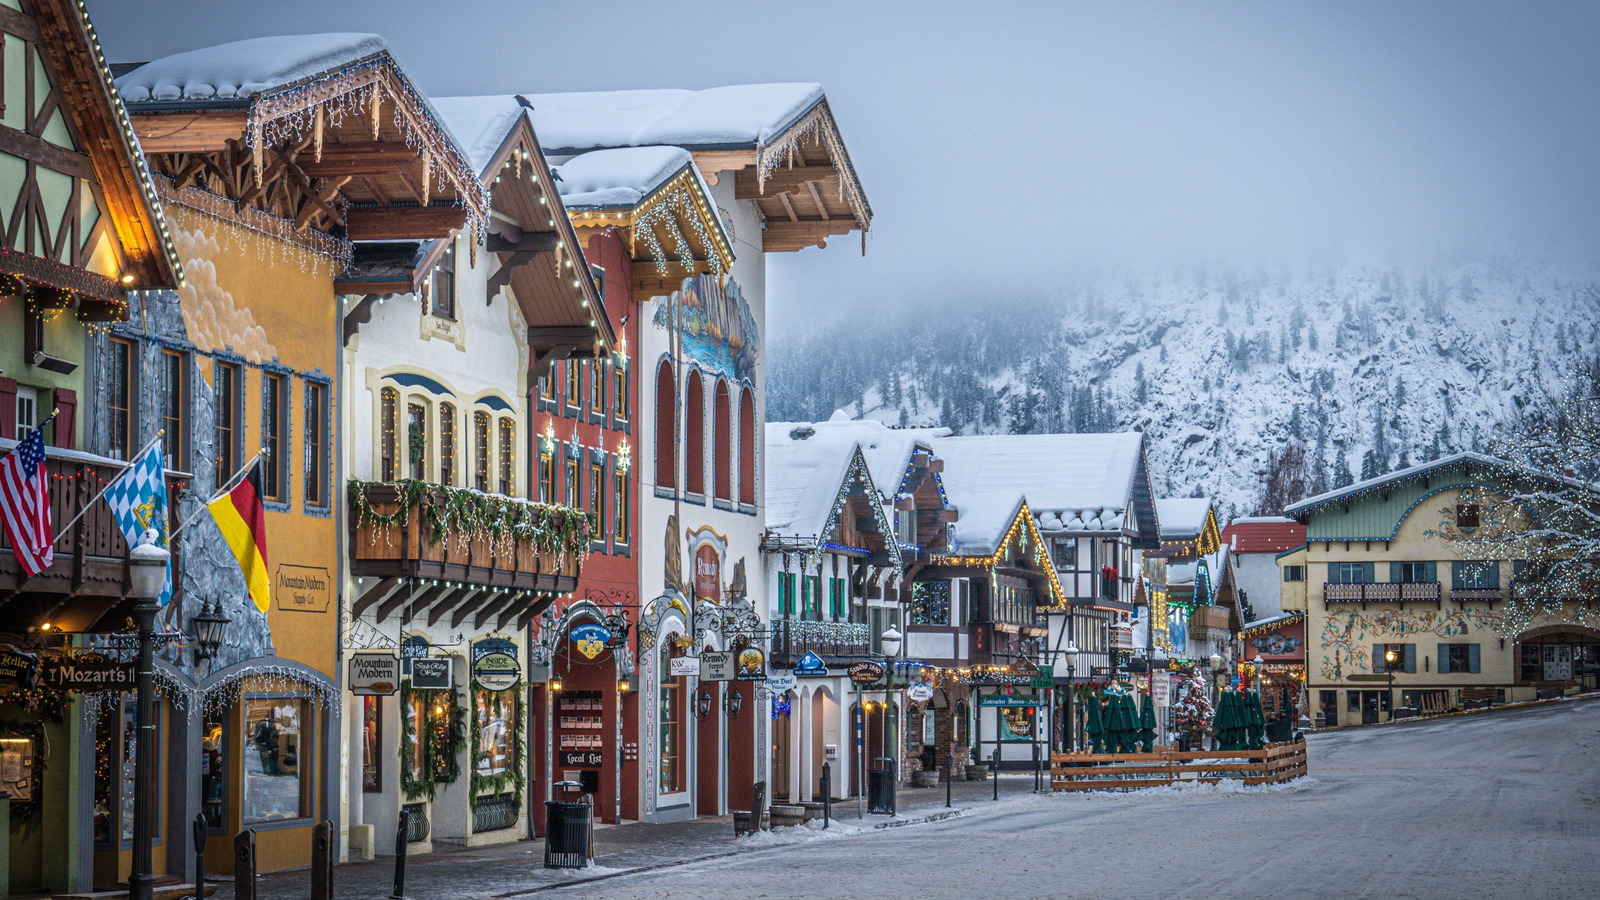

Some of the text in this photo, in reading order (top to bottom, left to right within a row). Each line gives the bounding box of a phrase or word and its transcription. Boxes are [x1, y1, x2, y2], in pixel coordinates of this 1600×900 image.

[1, 653, 29, 668] Keller
[354, 658, 393, 669] Mountain
[703, 653, 729, 663] Remedy
[671, 660, 684, 668] KW
[849, 662, 868, 674] Studio
[60, 666, 126, 685] Mozart's
[358, 668, 393, 678] Modern
[567, 753, 585, 765] Local
